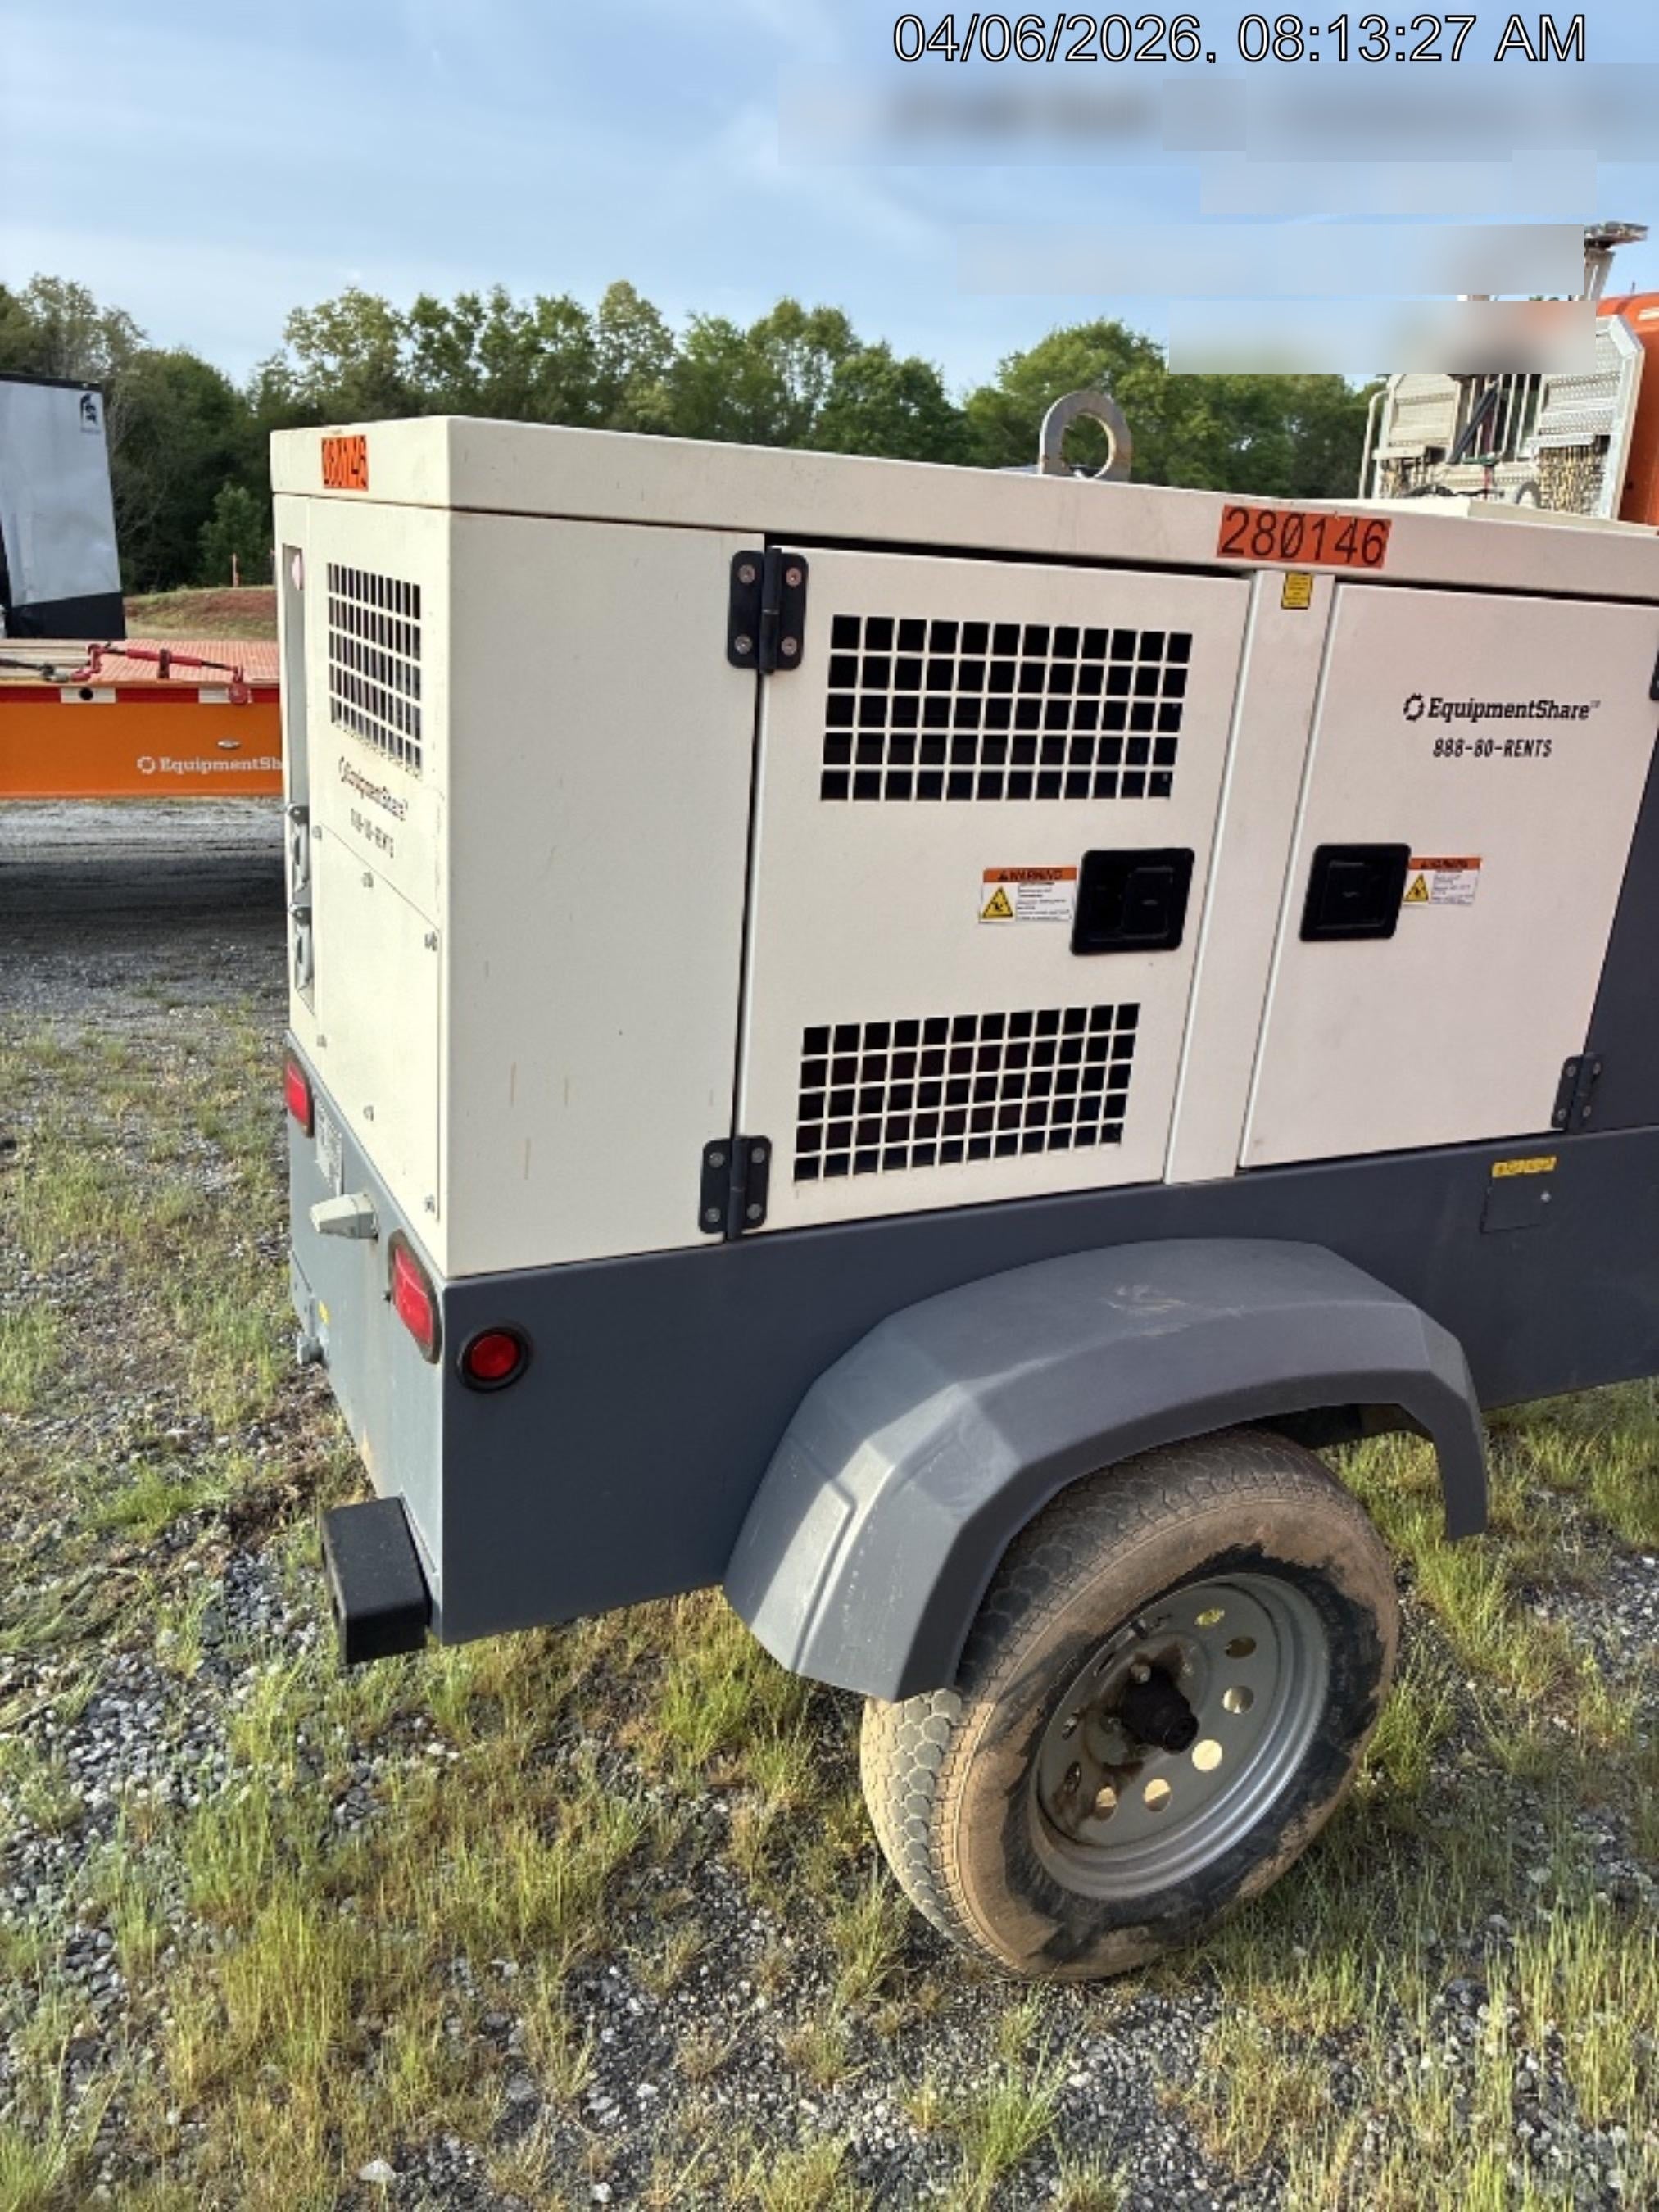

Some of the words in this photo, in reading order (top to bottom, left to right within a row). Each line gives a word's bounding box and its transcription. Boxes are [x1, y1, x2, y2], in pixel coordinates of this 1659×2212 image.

[1221, 506, 1387, 566] 280146
[1427, 697, 1591, 723] EquipmentShare
[1432, 738, 1552, 757] 888-80-RENTS
[159, 756, 283, 775] EquipmentSh
